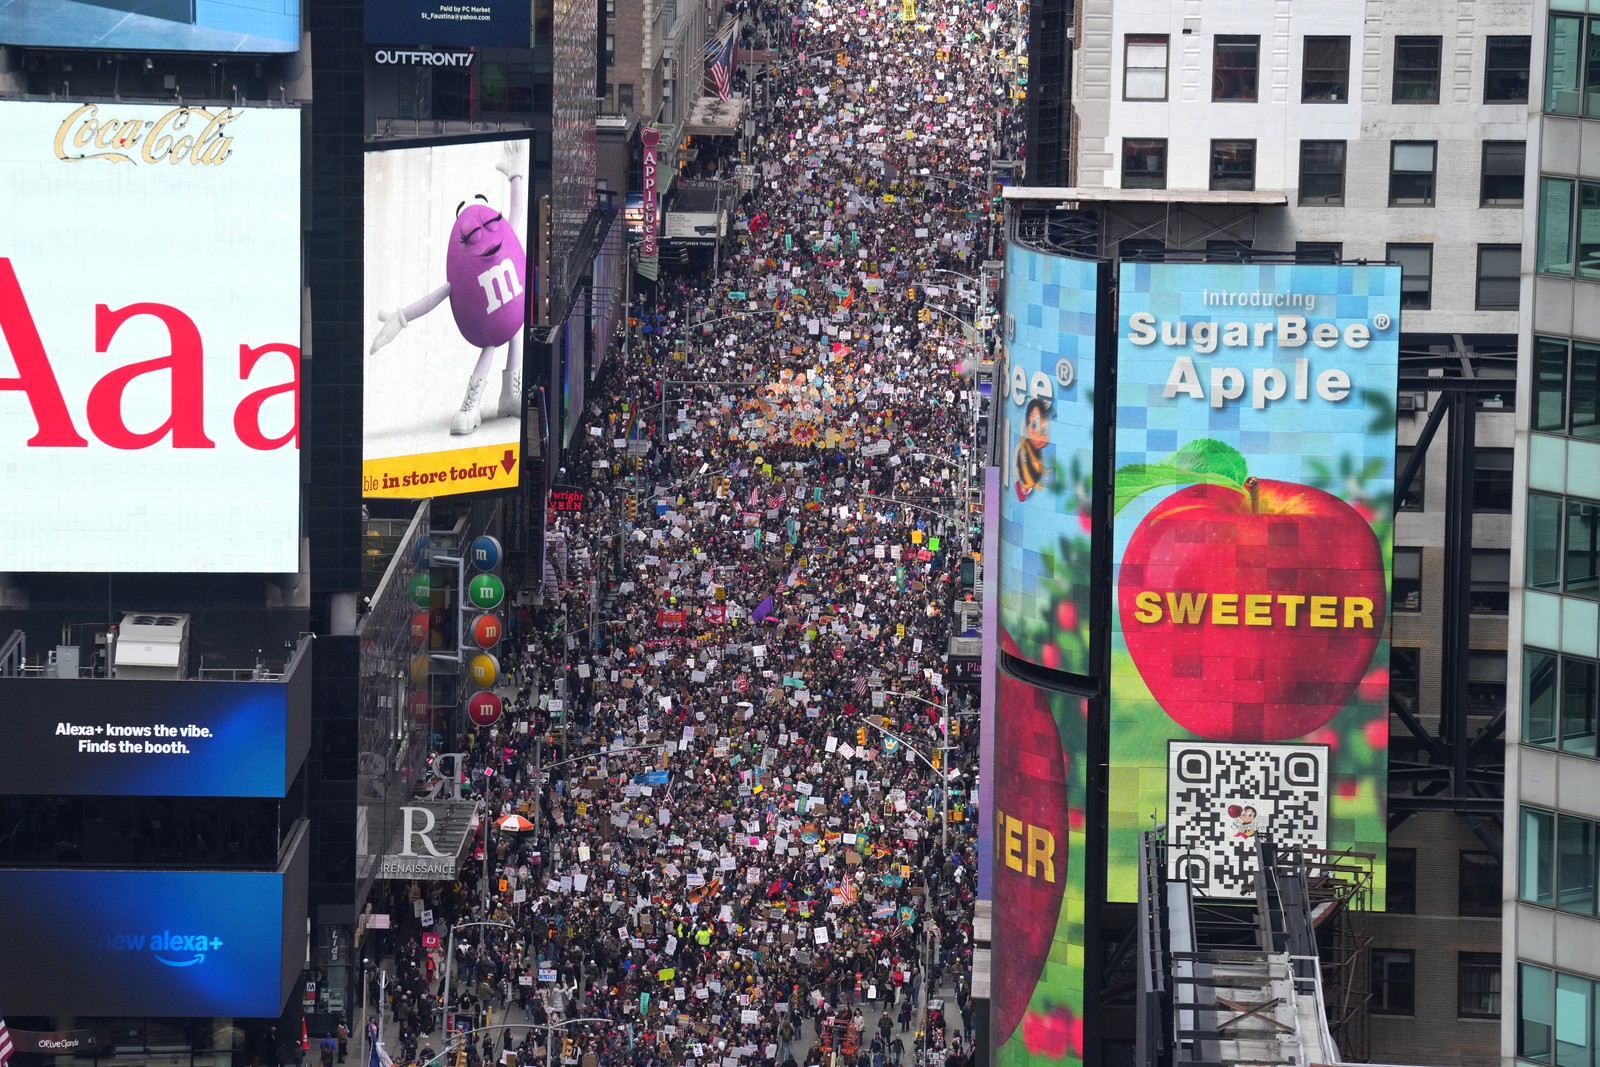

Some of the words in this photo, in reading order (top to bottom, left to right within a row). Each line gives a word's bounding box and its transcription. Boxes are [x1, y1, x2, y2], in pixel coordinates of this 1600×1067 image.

[1203, 288, 1316, 311] Introducing
[1161, 356, 1351, 409] Apple
[382, 473, 400, 489] in
[402, 469, 447, 487] store
[450, 463, 498, 481] today
[476, 548, 488, 561] m
[480, 586, 494, 598] m
[1134, 592, 1374, 628] SWEETER
[486, 625, 496, 638] m
[474, 666, 484, 678] m
[480, 703, 494, 716] m
[55, 722, 104, 736] Alexa+
[106, 723, 152, 737] knows
[154, 724, 178, 737] the
[180, 724, 213, 738] vibe.
[78, 740, 116, 753] Finds
[118, 740, 142, 753] the
[144, 740, 190, 754] booth.
[399, 806, 452, 857] R
[384, 864, 456, 874] RENAISSANCE
[149, 930, 223, 951] alexa+
[38, 1040, 60, 1049] Olive
